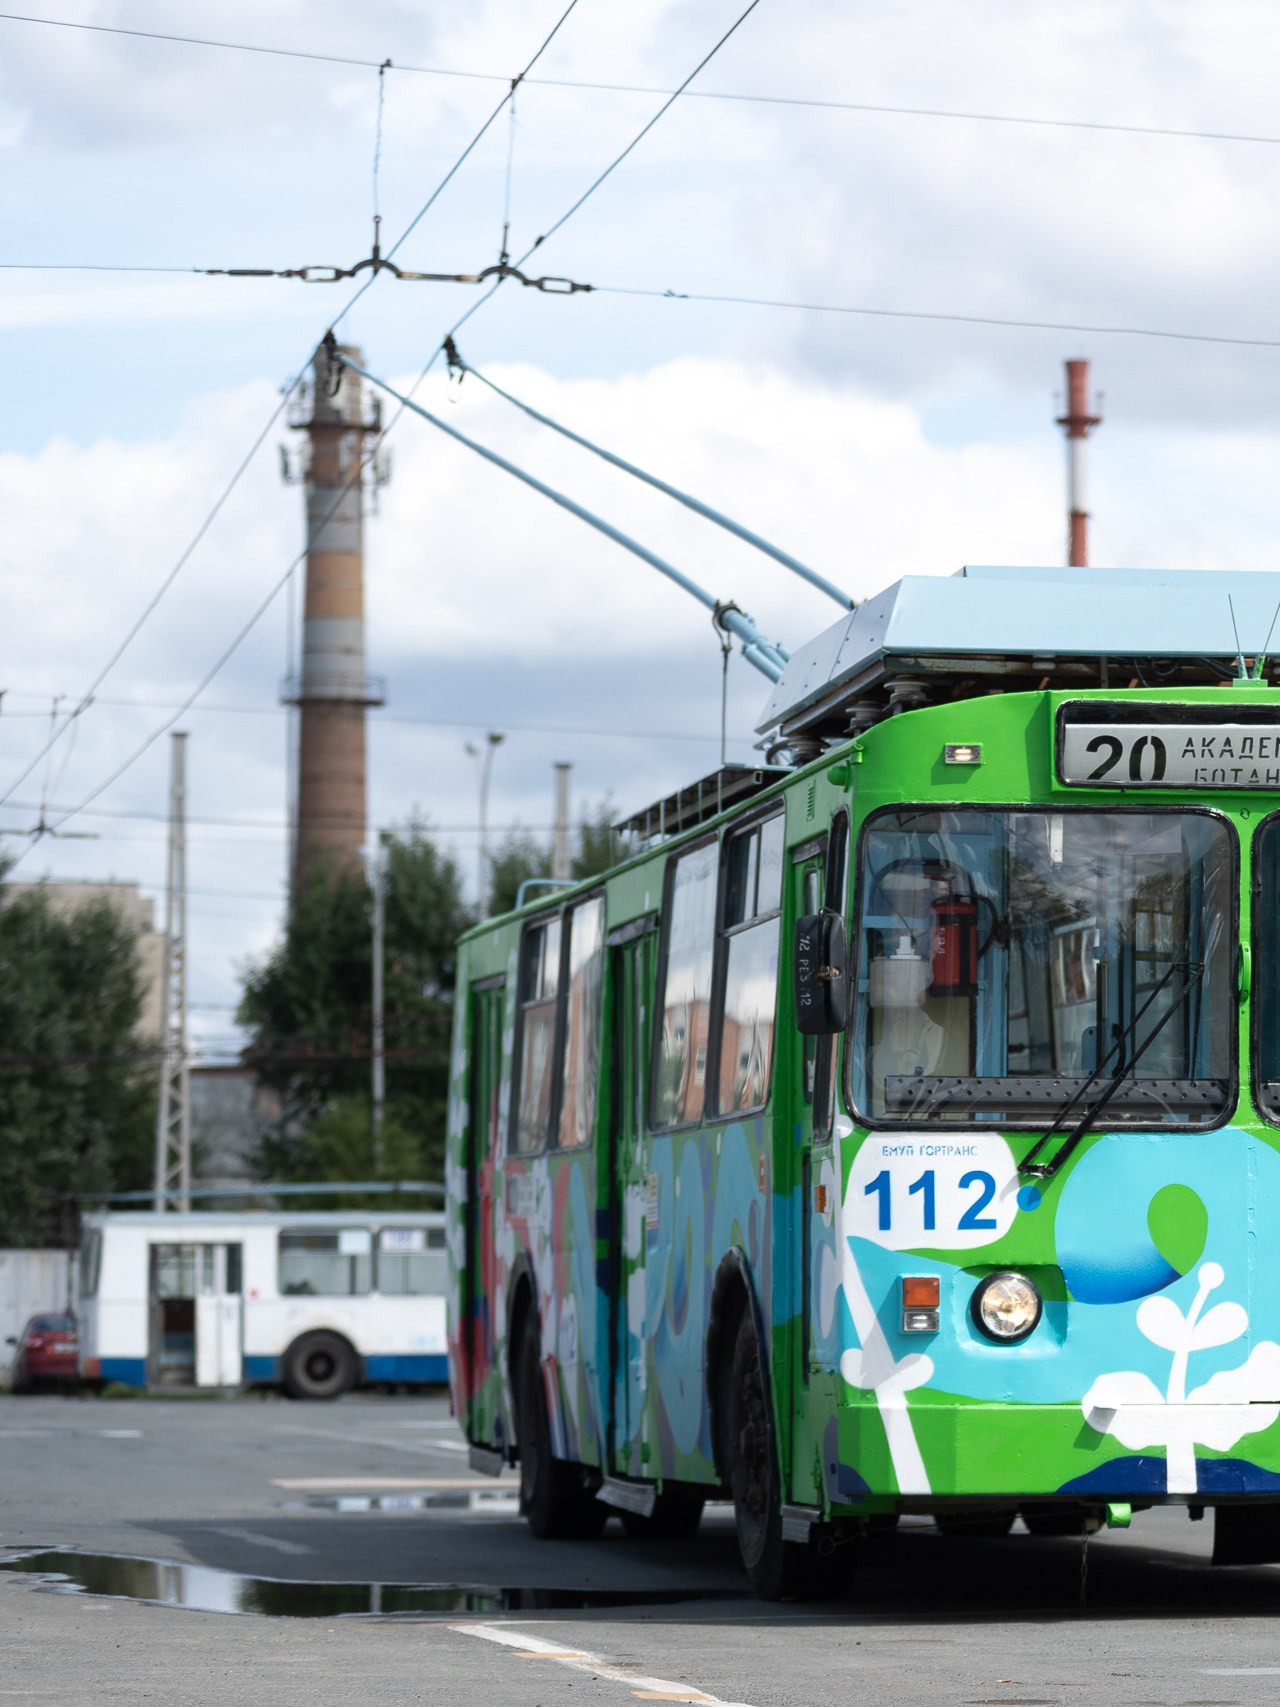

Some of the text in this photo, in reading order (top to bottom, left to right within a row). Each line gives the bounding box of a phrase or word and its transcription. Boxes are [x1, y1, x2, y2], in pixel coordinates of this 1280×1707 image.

[1086, 735, 1167, 781] 20
[882, 1145, 979, 1157] ЕМУП ГОРТРАНС
[864, 1170, 997, 1231] 112
